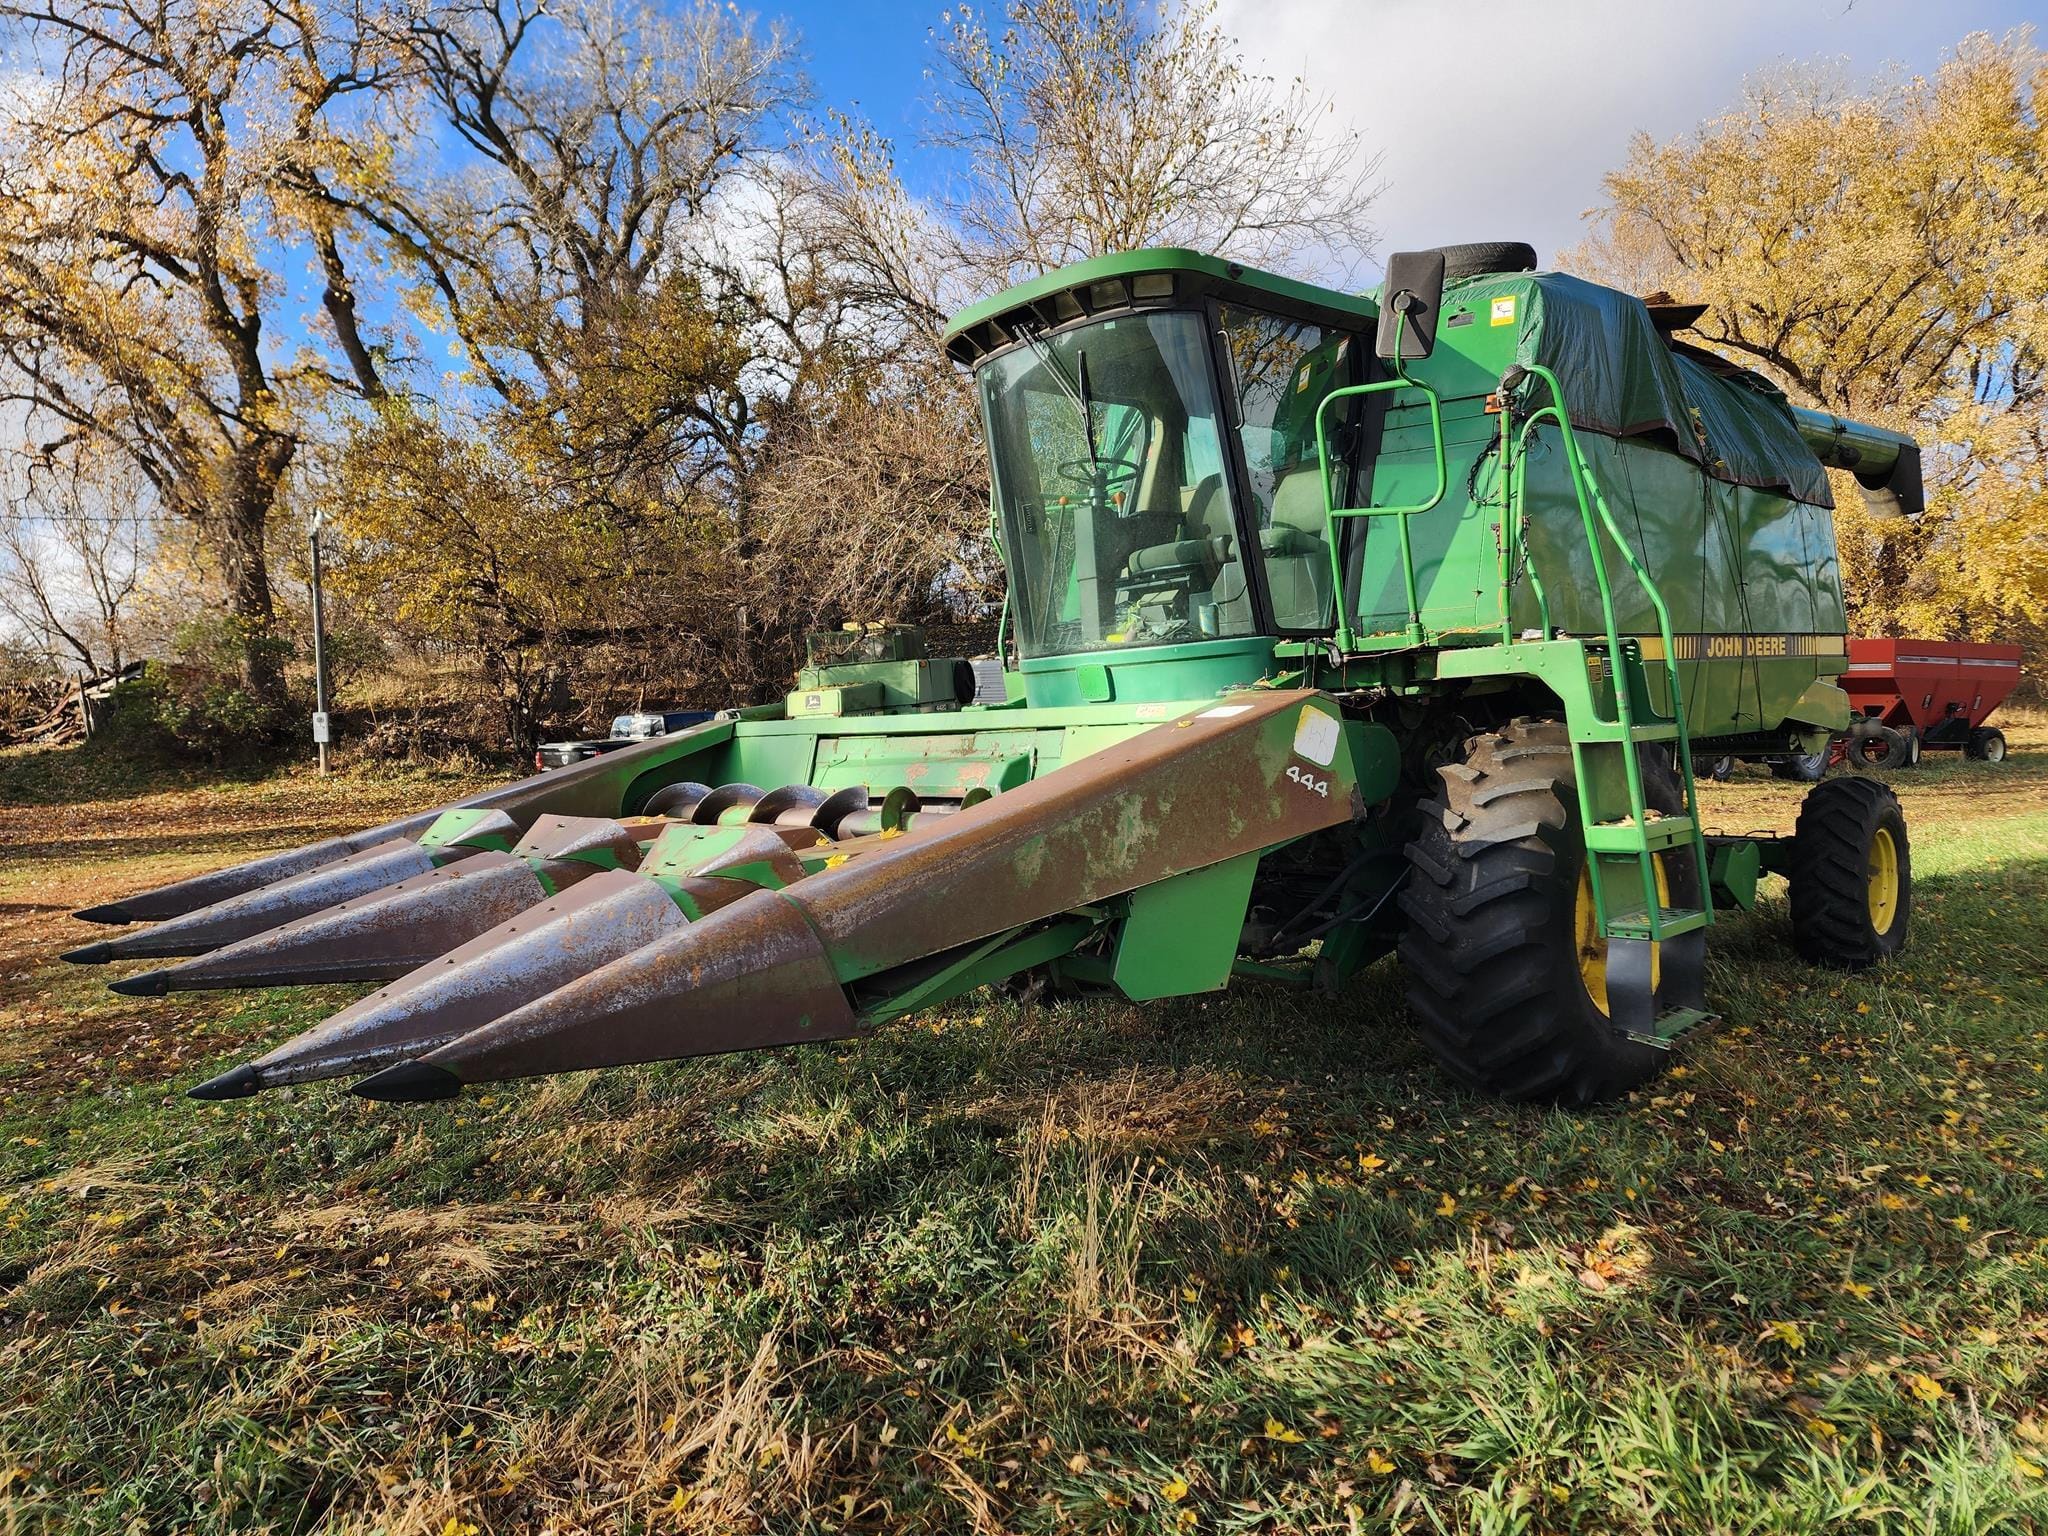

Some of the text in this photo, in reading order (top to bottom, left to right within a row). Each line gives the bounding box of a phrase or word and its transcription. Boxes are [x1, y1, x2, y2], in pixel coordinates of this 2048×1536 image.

[1707, 636, 1786, 658] JOHN DEERE
[1286, 766, 1328, 798] 444
